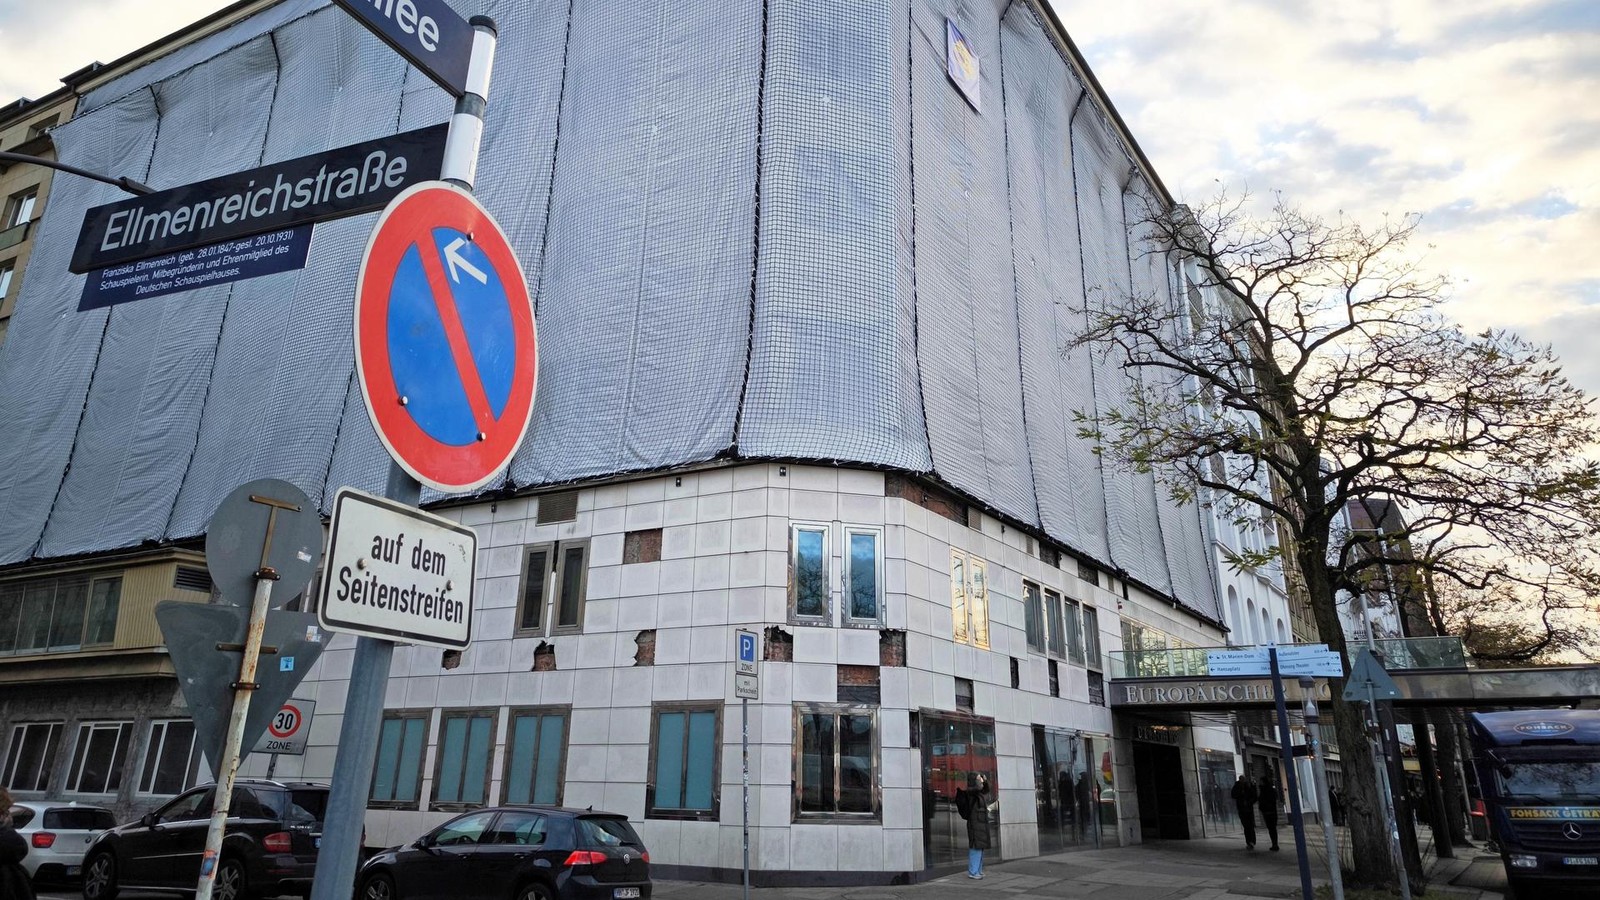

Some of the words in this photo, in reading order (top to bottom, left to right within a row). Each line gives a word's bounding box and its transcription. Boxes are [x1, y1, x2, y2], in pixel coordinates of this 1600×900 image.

[100, 150, 407, 252] Ellmenreichstraße
[102, 265, 134, 279] Franziska
[135, 255, 176, 272] Ellmenreich
[255, 229, 294, 246] 20.10.1931)
[152, 260, 204, 280] Mitbegründerin
[206, 257, 220, 269] und
[222, 246, 274, 266] Ehrenmitglied
[275, 244, 290, 255] des
[135, 280, 173, 295] Deutschen
[371, 533, 404, 565] auf
[411, 538, 446, 577] dem
[336, 566, 464, 624] Seitenstreifen
[744, 639, 750, 657] P
[741, 663, 753, 673] ZONE
[275, 712, 294, 730] 30
[266, 741, 292, 751] ZONE
[1510, 809, 1560, 818] FOHSACK
